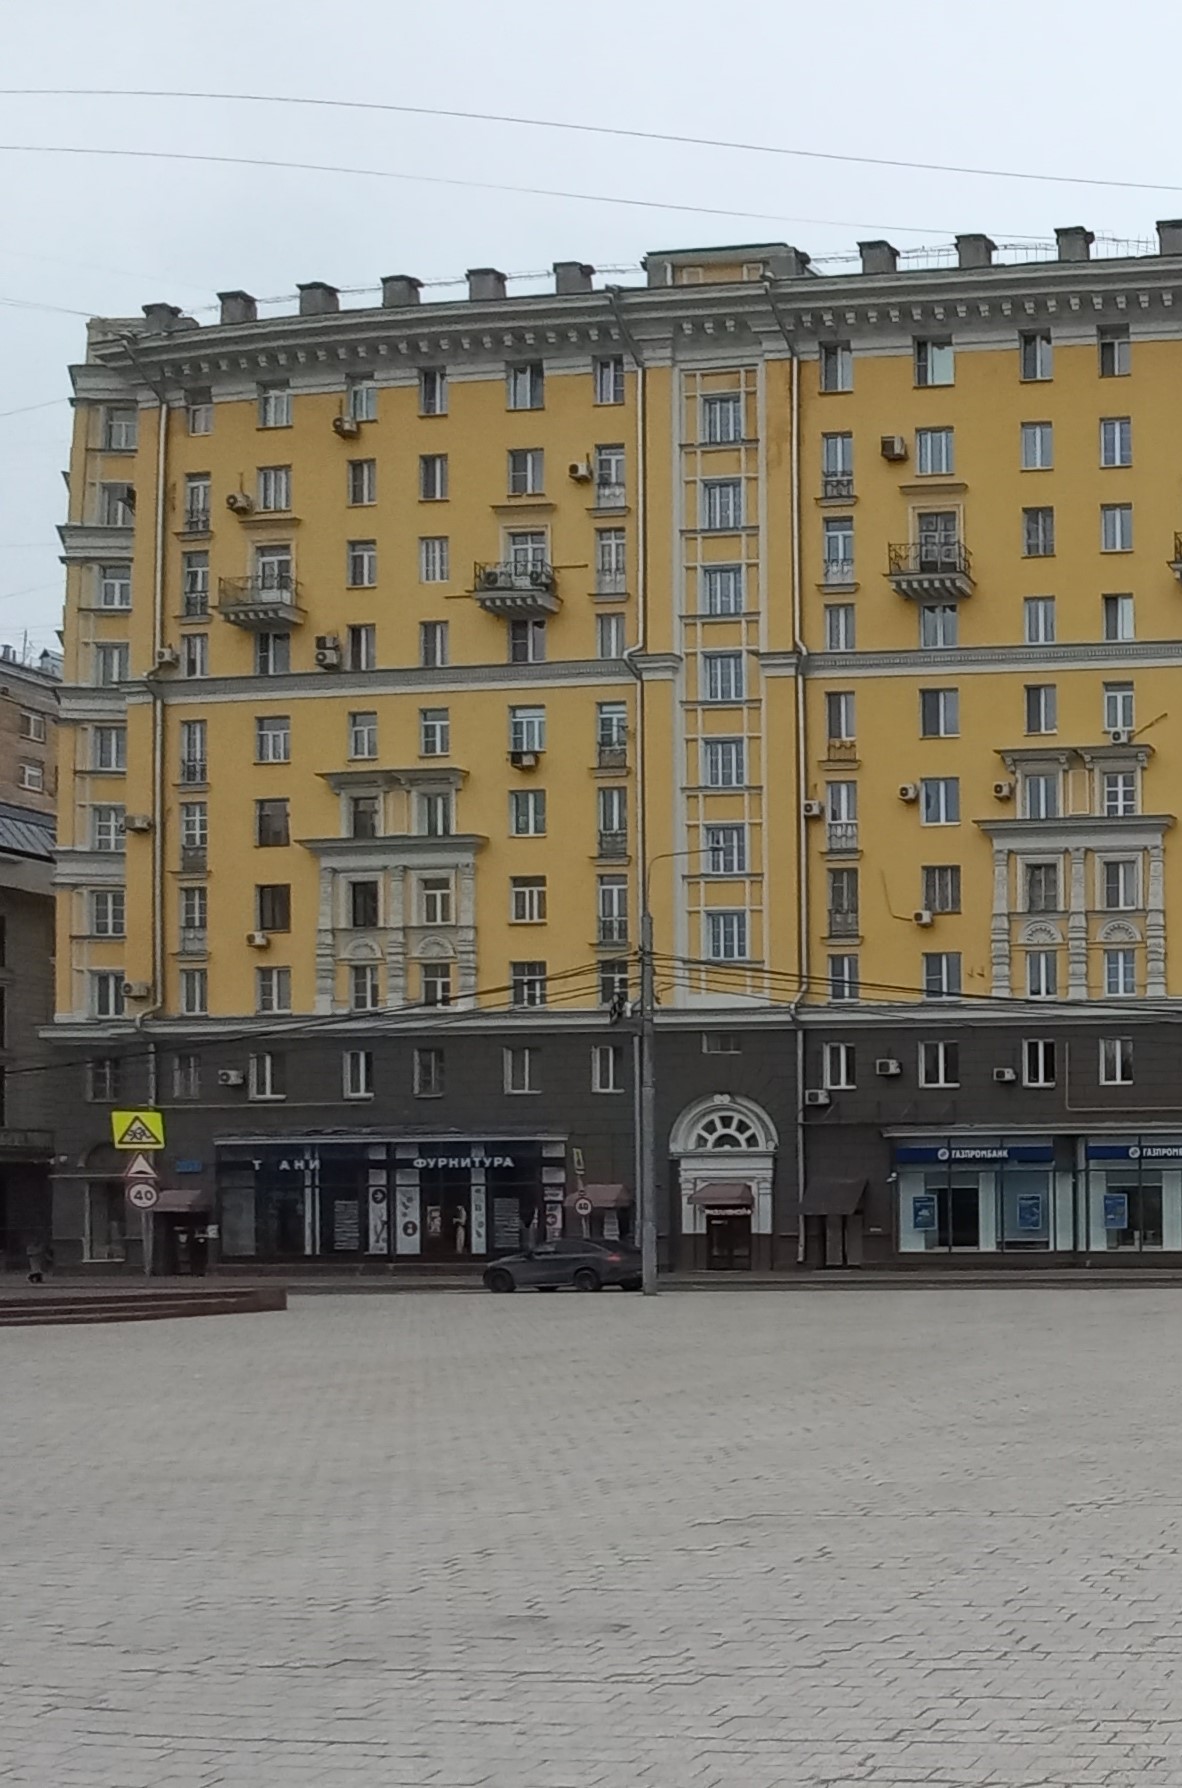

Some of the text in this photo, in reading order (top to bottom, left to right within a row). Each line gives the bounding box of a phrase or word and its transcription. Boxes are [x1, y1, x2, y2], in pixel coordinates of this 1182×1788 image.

[951, 1149, 1009, 1159] ГАЗПРОМБАНК
[413, 1157, 515, 1169] ФУРНИТУРА
[133, 1189, 154, 1201] 40
[577, 1202, 590, 1211] 40
